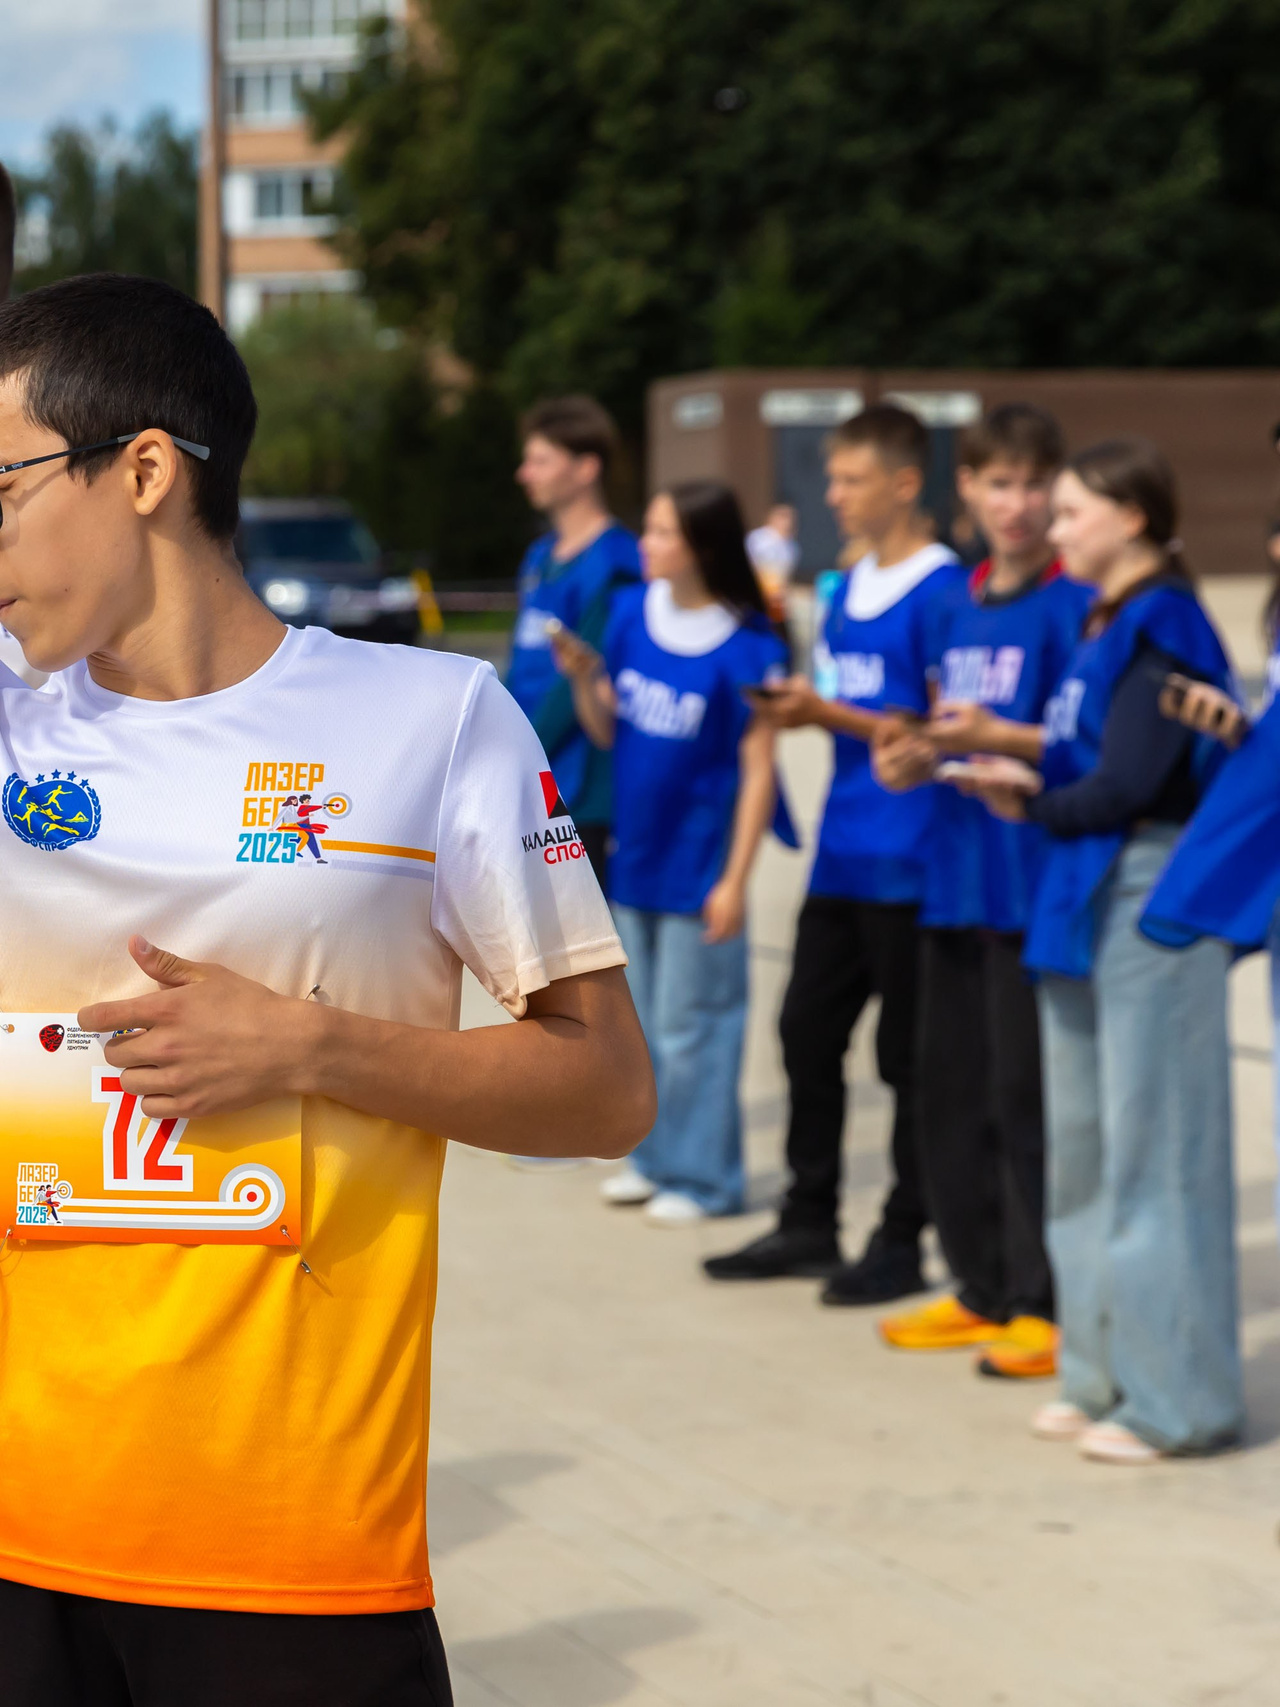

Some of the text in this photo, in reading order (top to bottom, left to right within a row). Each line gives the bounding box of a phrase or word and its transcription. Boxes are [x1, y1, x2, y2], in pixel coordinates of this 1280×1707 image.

[244, 762, 325, 791] ЛАЗЕР
[236, 832, 297, 863] 2025
[19, 1165, 56, 1182] ЛАЗЕР
[19, 1185, 39, 1202] БЕГ
[18, 1206, 47, 1223] 2025
